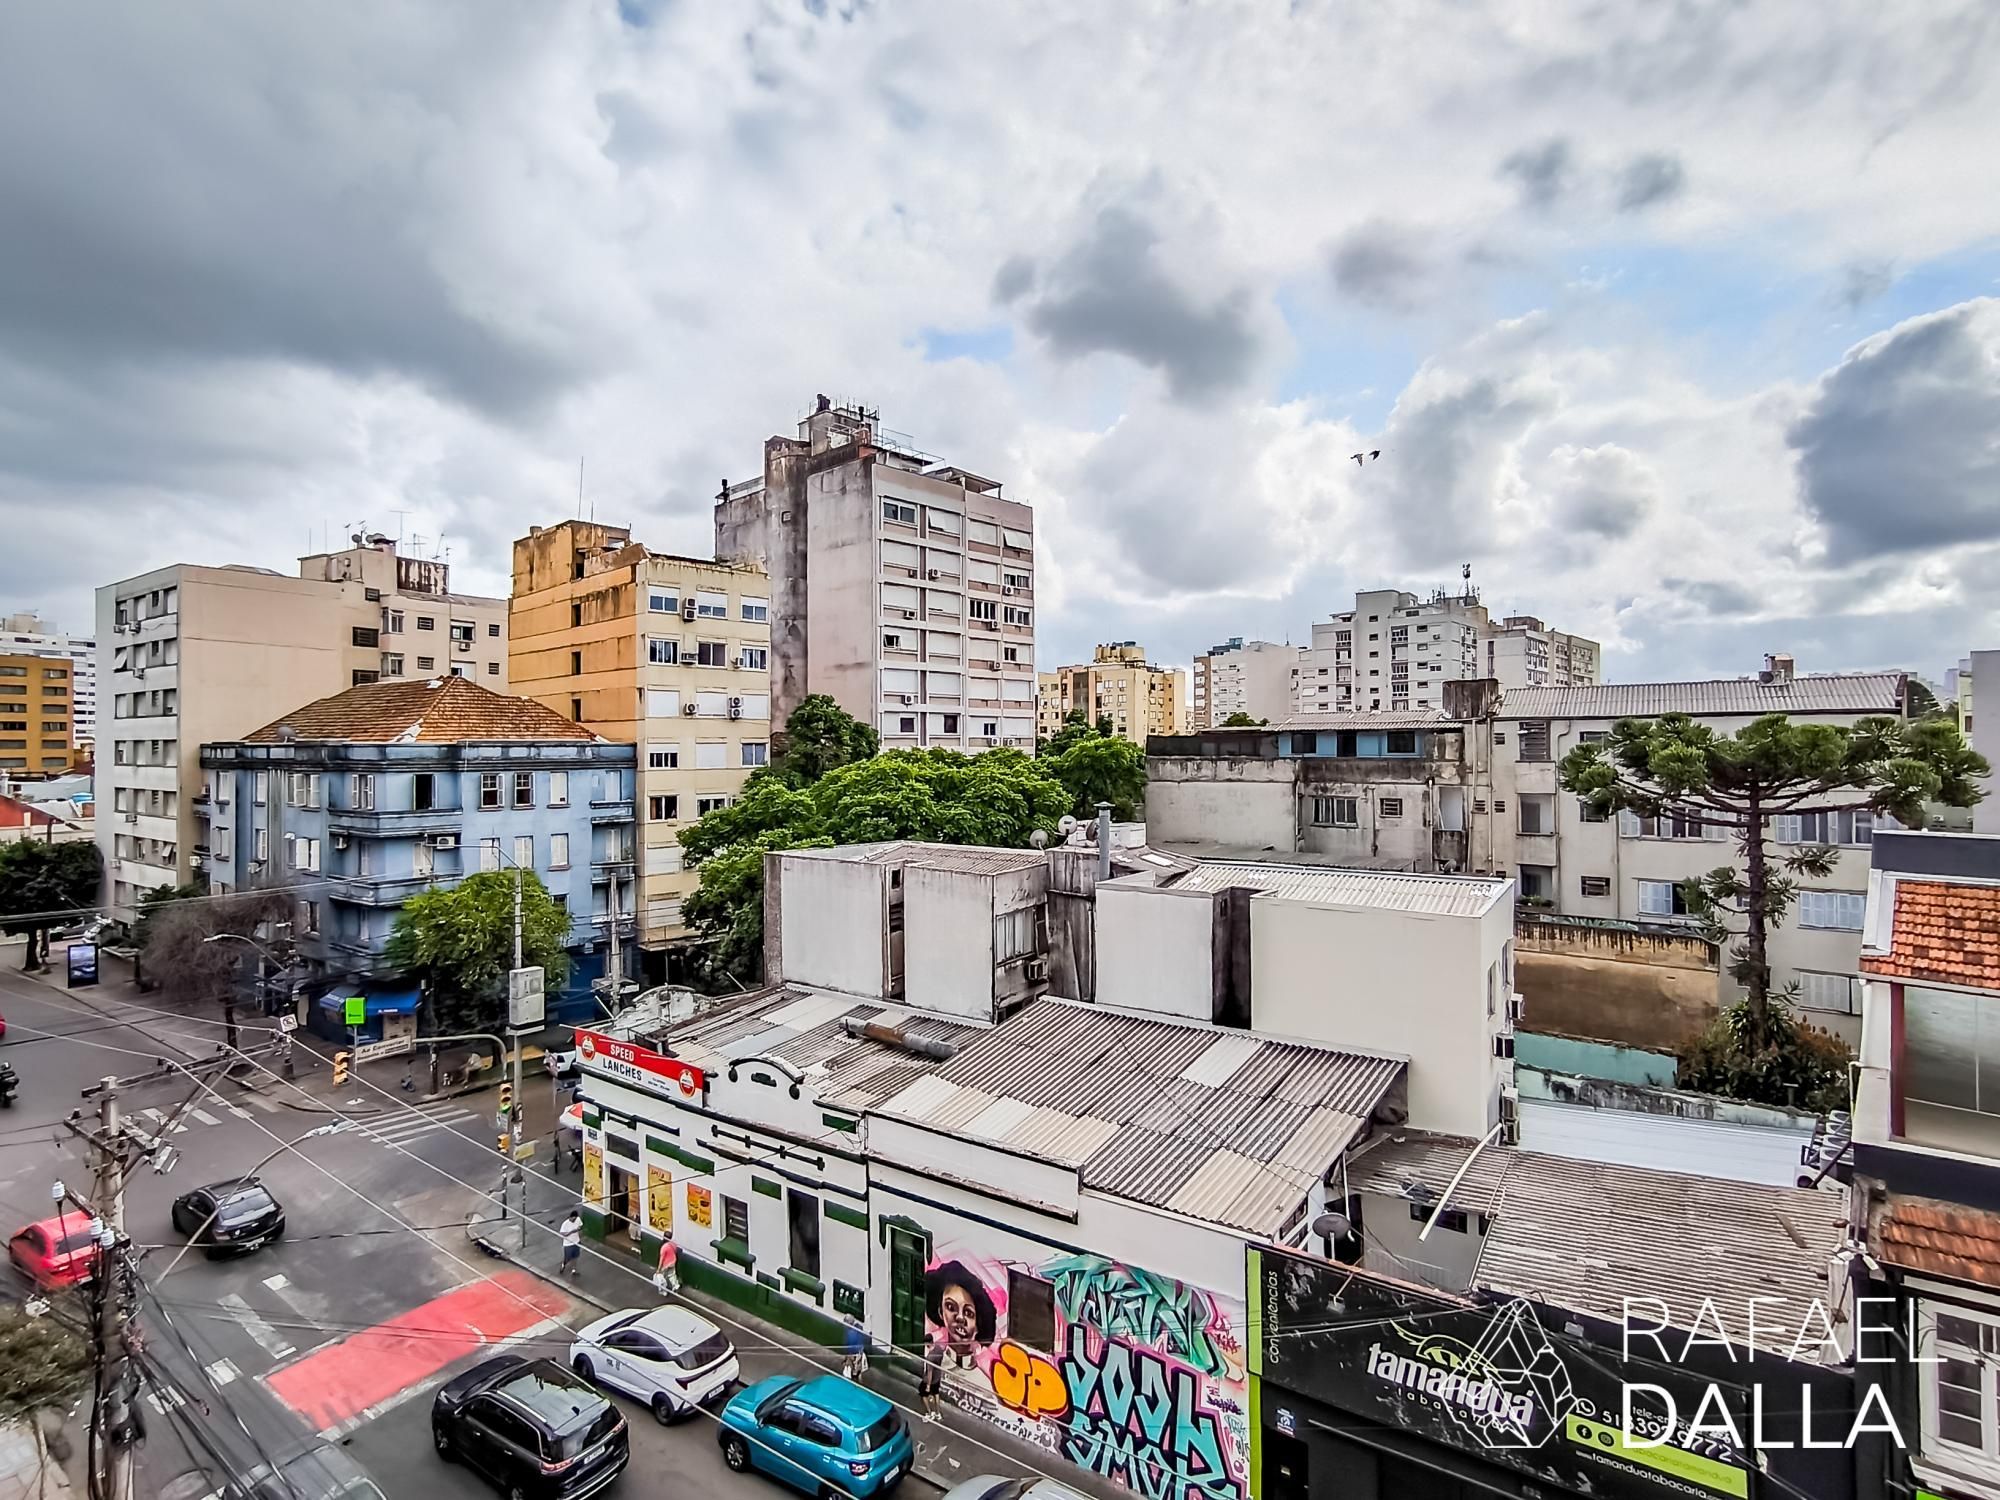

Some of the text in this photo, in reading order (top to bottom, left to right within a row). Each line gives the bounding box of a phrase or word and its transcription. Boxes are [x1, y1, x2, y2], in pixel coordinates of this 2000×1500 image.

[610, 1044, 635, 1062] SPEED
[602, 1058, 643, 1082] LANCHES
[1367, 1342, 1534, 1427] tamanduá
